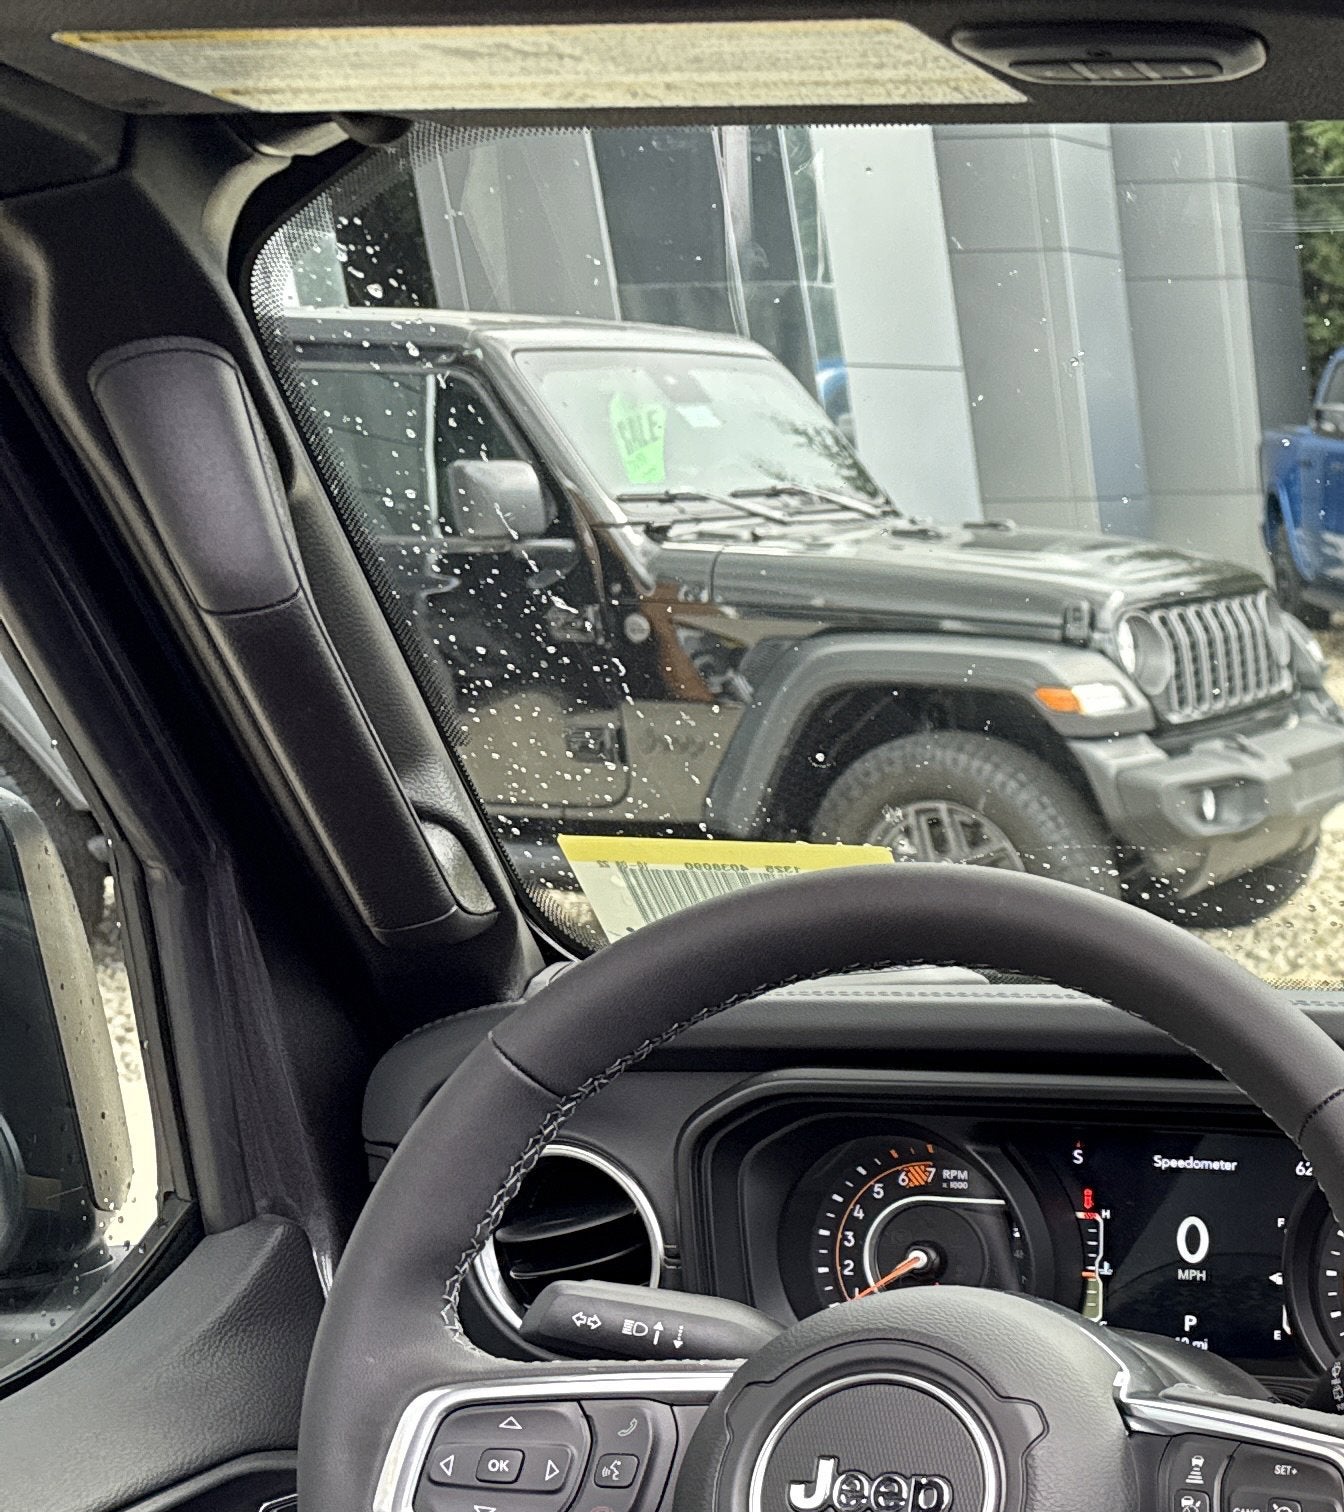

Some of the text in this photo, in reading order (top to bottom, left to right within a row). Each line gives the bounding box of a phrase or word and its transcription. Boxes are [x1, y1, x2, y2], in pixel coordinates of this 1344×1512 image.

[1153, 1154, 1238, 1172] Speedometer
[898, 1171, 909, 1186] 6
[925, 1167, 936, 1183] 7
[942, 1169, 968, 1181] RPM
[872, 1183, 884, 1199] 5
[853, 1204, 865, 1220] 4
[1101, 1209, 1111, 1219] H
[1277, 1218, 1285, 1228] F
[843, 1231, 855, 1247] 3
[1176, 1215, 1210, 1264] 0
[843, 1260, 854, 1276] 2
[1177, 1269, 1207, 1282] MPH
[1184, 1315, 1198, 1331] P
[1273, 1330, 1282, 1341] E
[488, 1458, 510, 1472] OK
